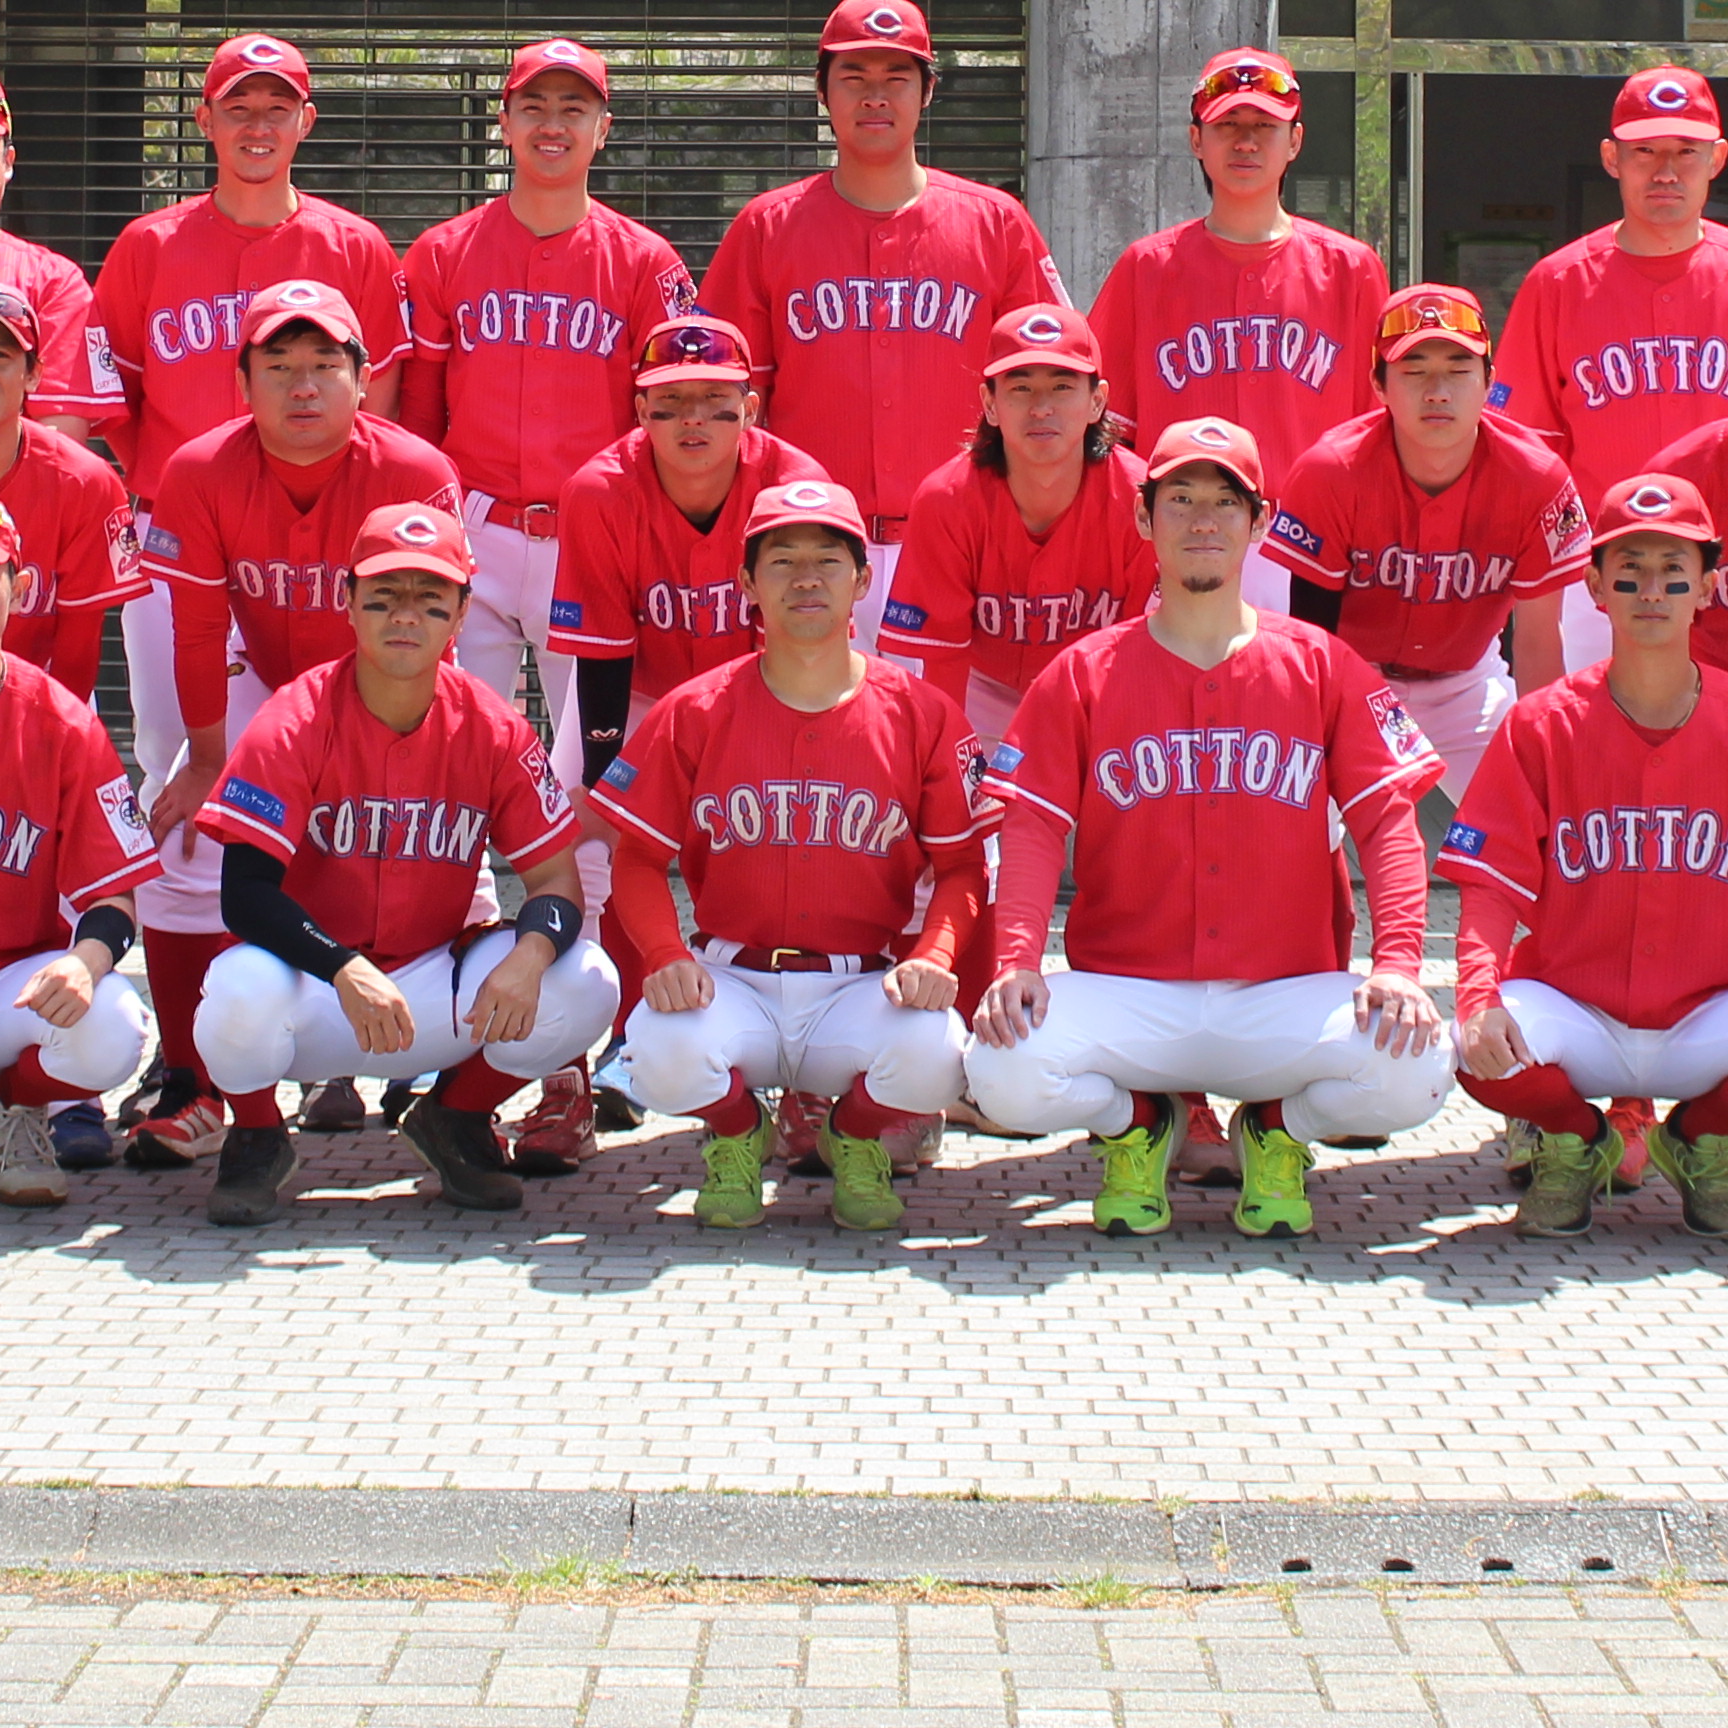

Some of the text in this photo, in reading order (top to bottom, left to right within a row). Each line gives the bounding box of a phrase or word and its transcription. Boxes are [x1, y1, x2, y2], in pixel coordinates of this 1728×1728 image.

[455, 288, 624, 360] COTTON
[783, 276, 982, 345] COTTON
[1153, 314, 1343, 395] COTTON
[1275, 515, 1316, 550] BOX
[975, 587, 1124, 646] OTTON
[1095, 727, 1326, 811] COTTON
[306, 795, 488, 866] COTTON
[692, 779, 911, 857] COTTON
